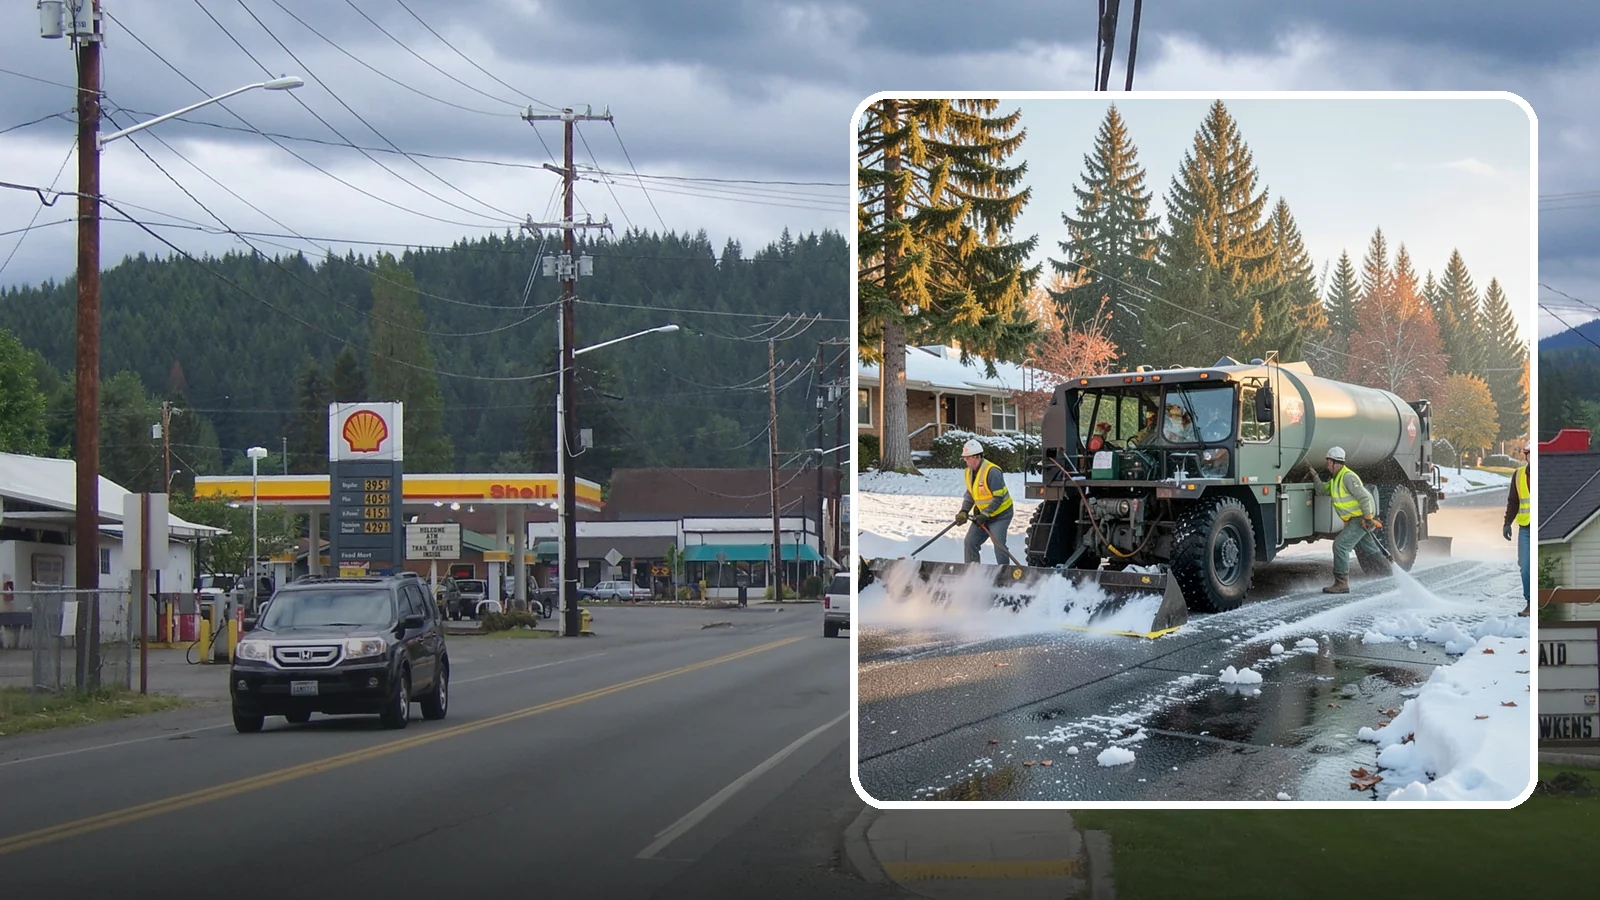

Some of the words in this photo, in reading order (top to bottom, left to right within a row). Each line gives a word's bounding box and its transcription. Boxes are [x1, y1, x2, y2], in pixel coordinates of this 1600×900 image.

[366, 480, 384, 490] 395
[490, 484, 547, 499] Shell
[366, 494, 384, 504] 405
[366, 508, 384, 518] 415
[366, 522, 384, 533] 429
